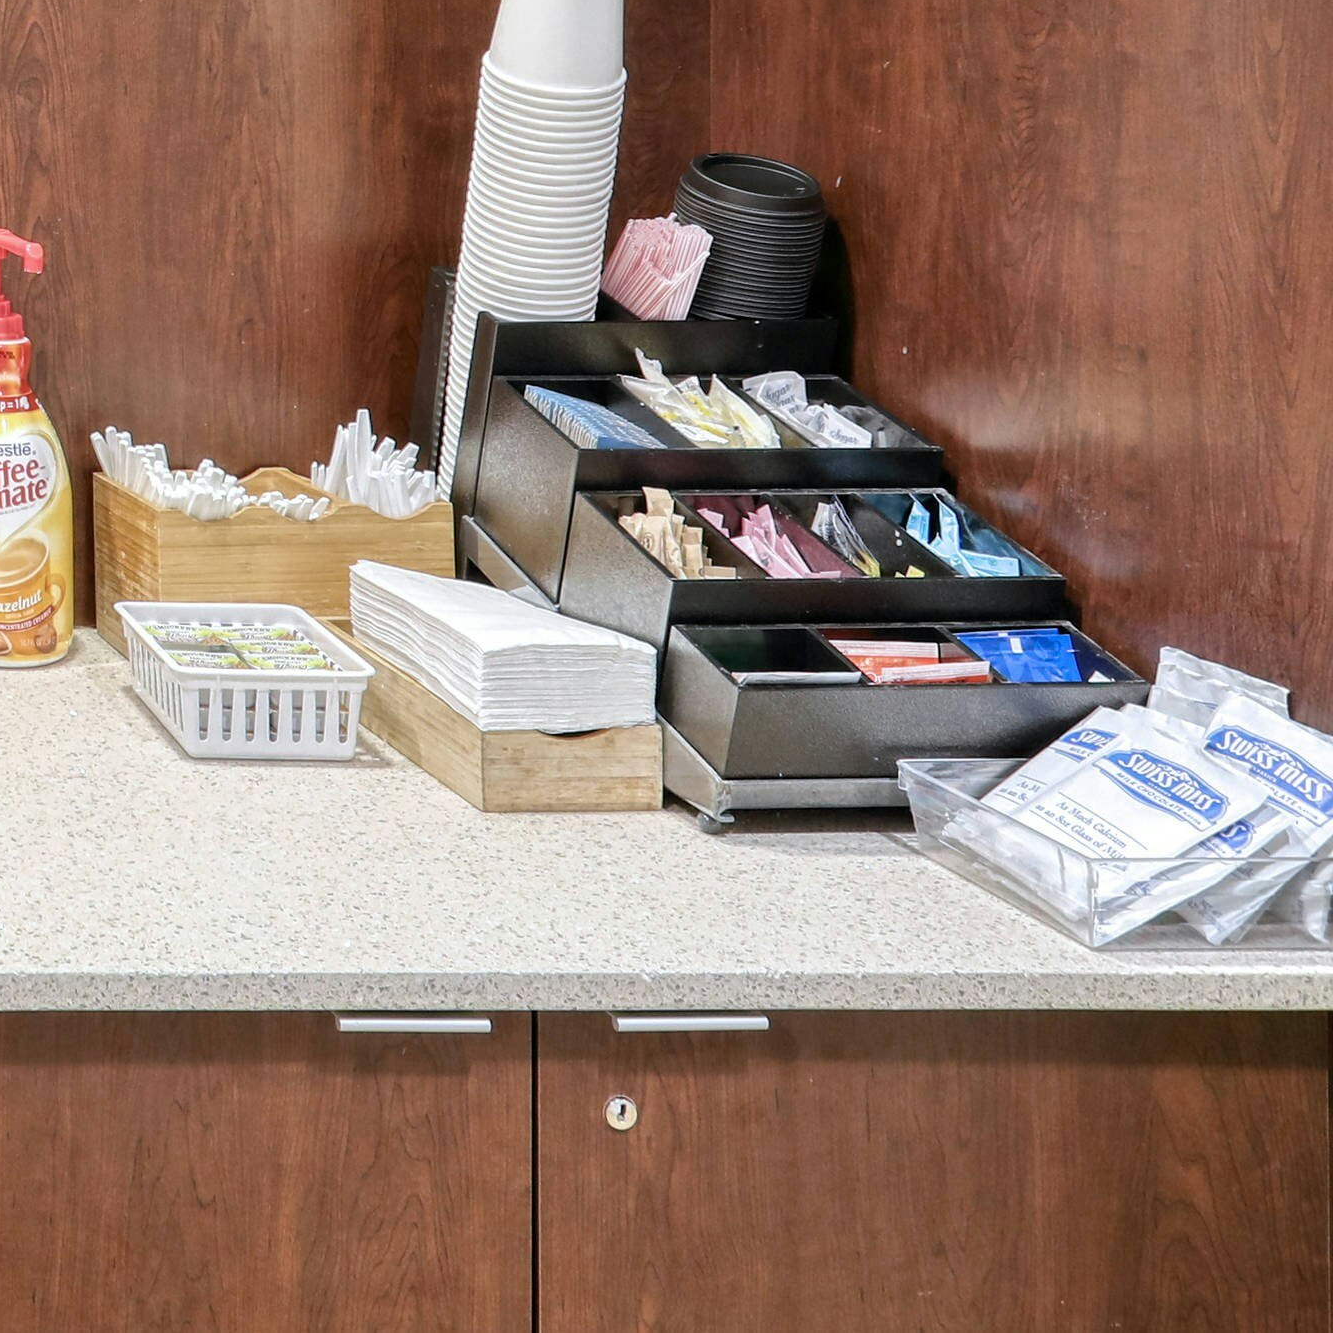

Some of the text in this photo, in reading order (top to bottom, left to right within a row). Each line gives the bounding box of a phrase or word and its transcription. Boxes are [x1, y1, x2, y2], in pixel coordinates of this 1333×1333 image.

[1117, 772, 1136, 786] MILK
[1136, 783, 1183, 813] CHOCOLATE
[1044, 809, 1055, 818] an
[1071, 823, 1094, 843] Glass
[1092, 838, 1106, 850] of
[1055, 801, 1127, 849] As Much Calcium
